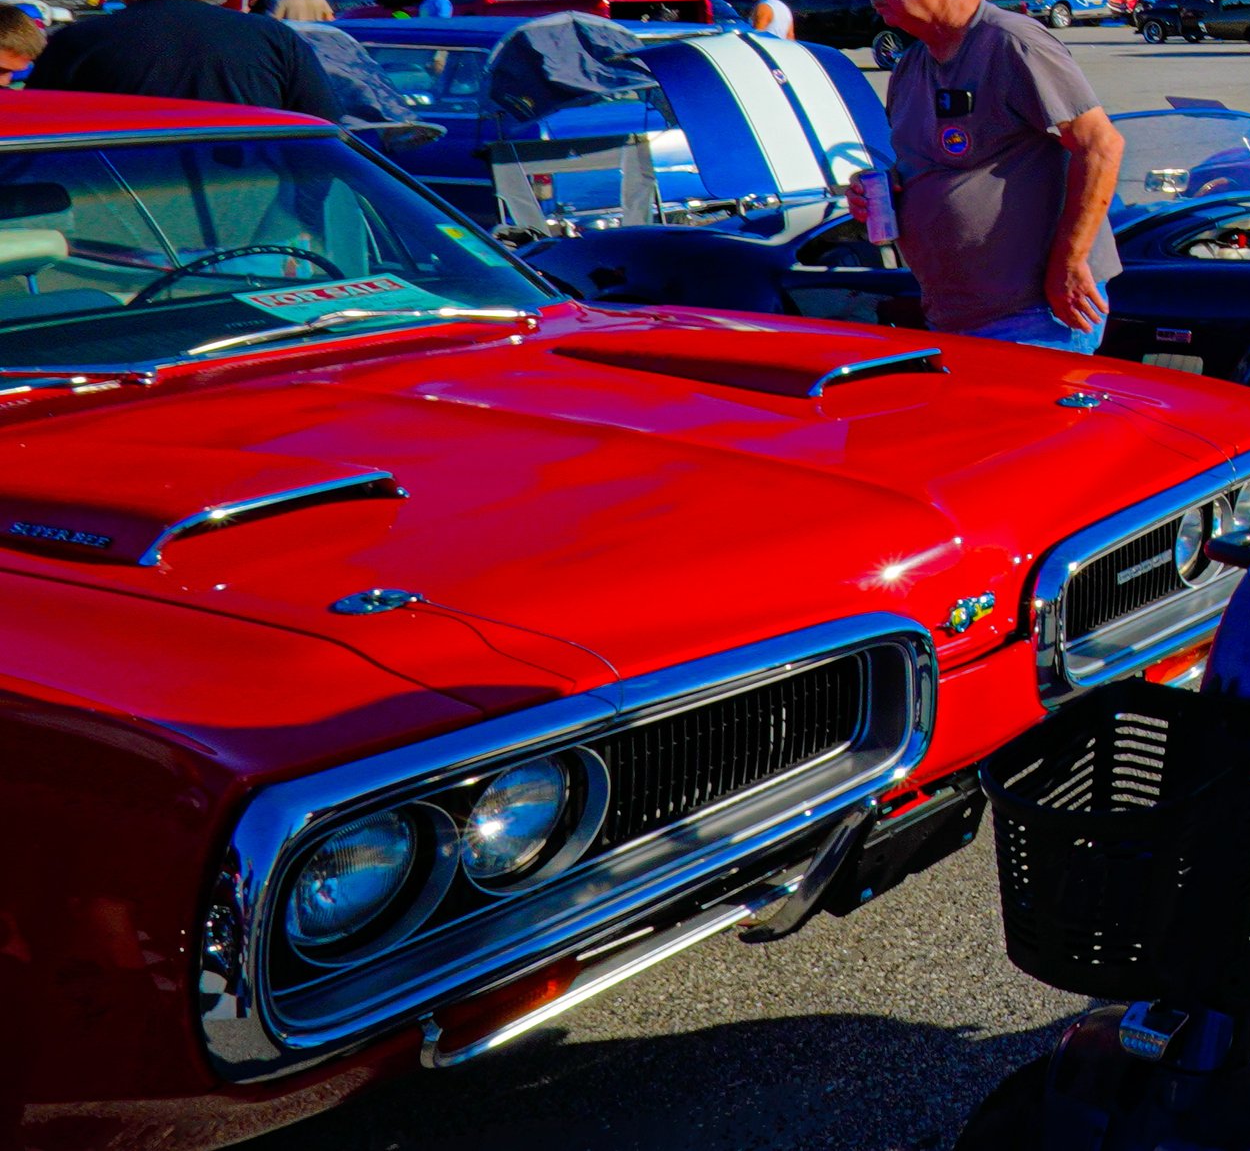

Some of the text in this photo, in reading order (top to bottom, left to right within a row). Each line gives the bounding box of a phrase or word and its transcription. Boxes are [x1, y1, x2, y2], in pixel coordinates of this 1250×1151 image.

[256, 291, 317, 308] FOR
[323, 278, 404, 299] SALE
[69, 532, 111, 548] BEE
